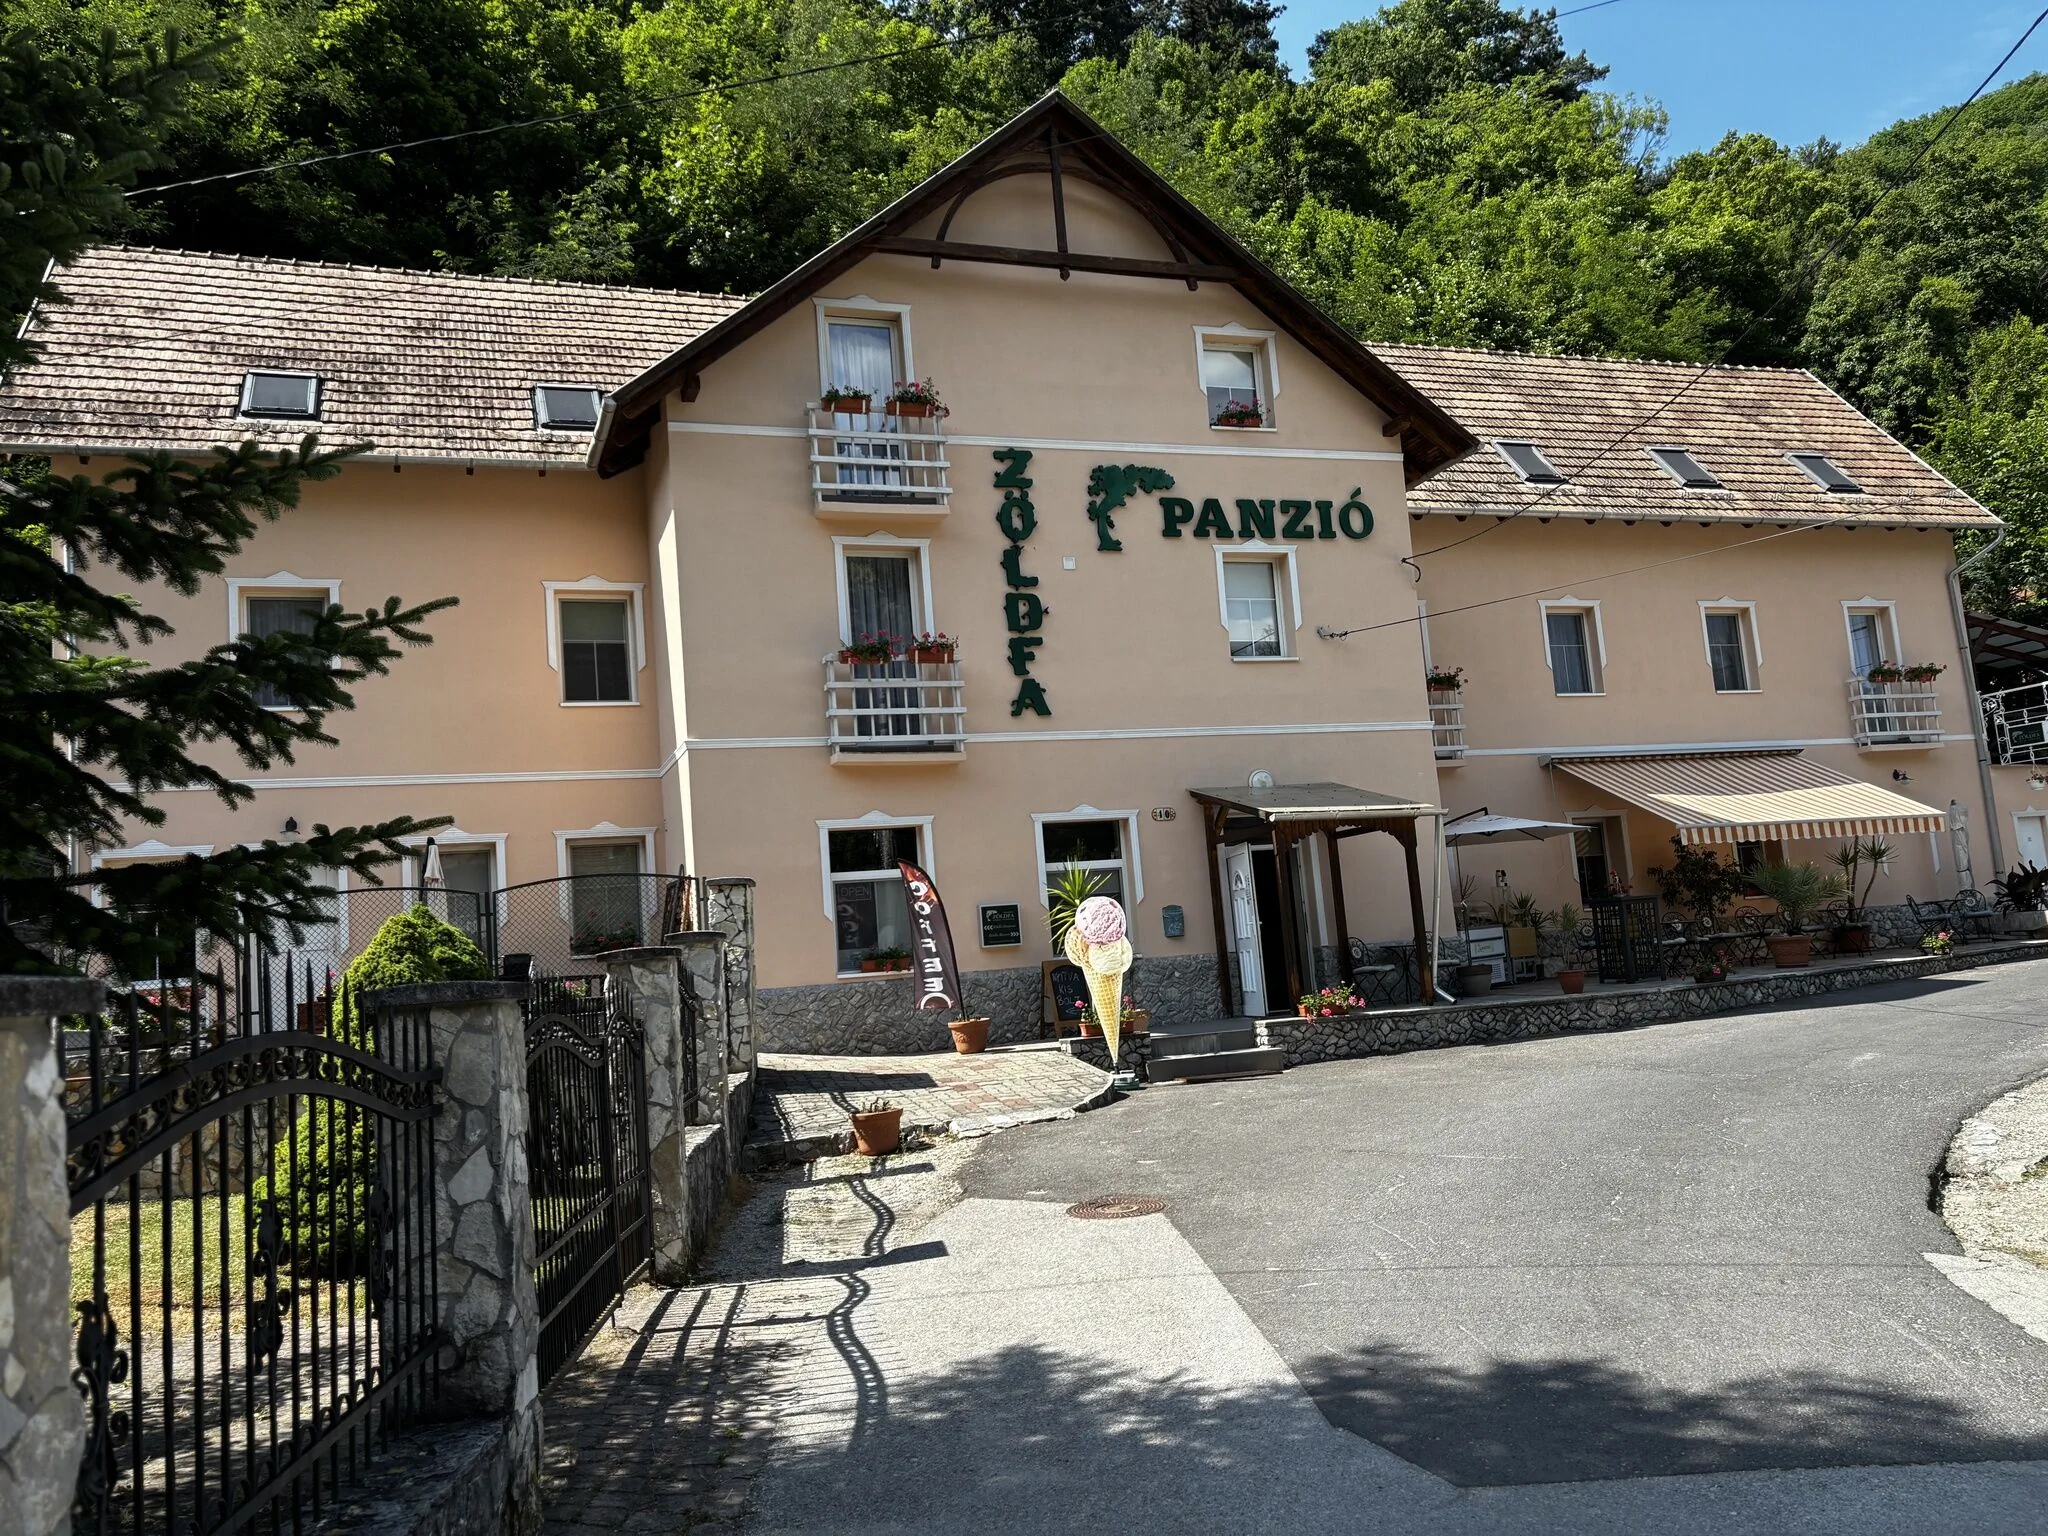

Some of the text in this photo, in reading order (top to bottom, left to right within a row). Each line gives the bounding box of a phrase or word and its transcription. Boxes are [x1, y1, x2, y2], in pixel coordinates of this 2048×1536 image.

[1159, 487, 1375, 539] PANZIÓ
[993, 448, 1051, 717] ZÖLDFA
[1158, 809, 1170, 819] 10
[841, 886, 870, 897] OPEN
[1059, 984, 1073, 994] KIS
